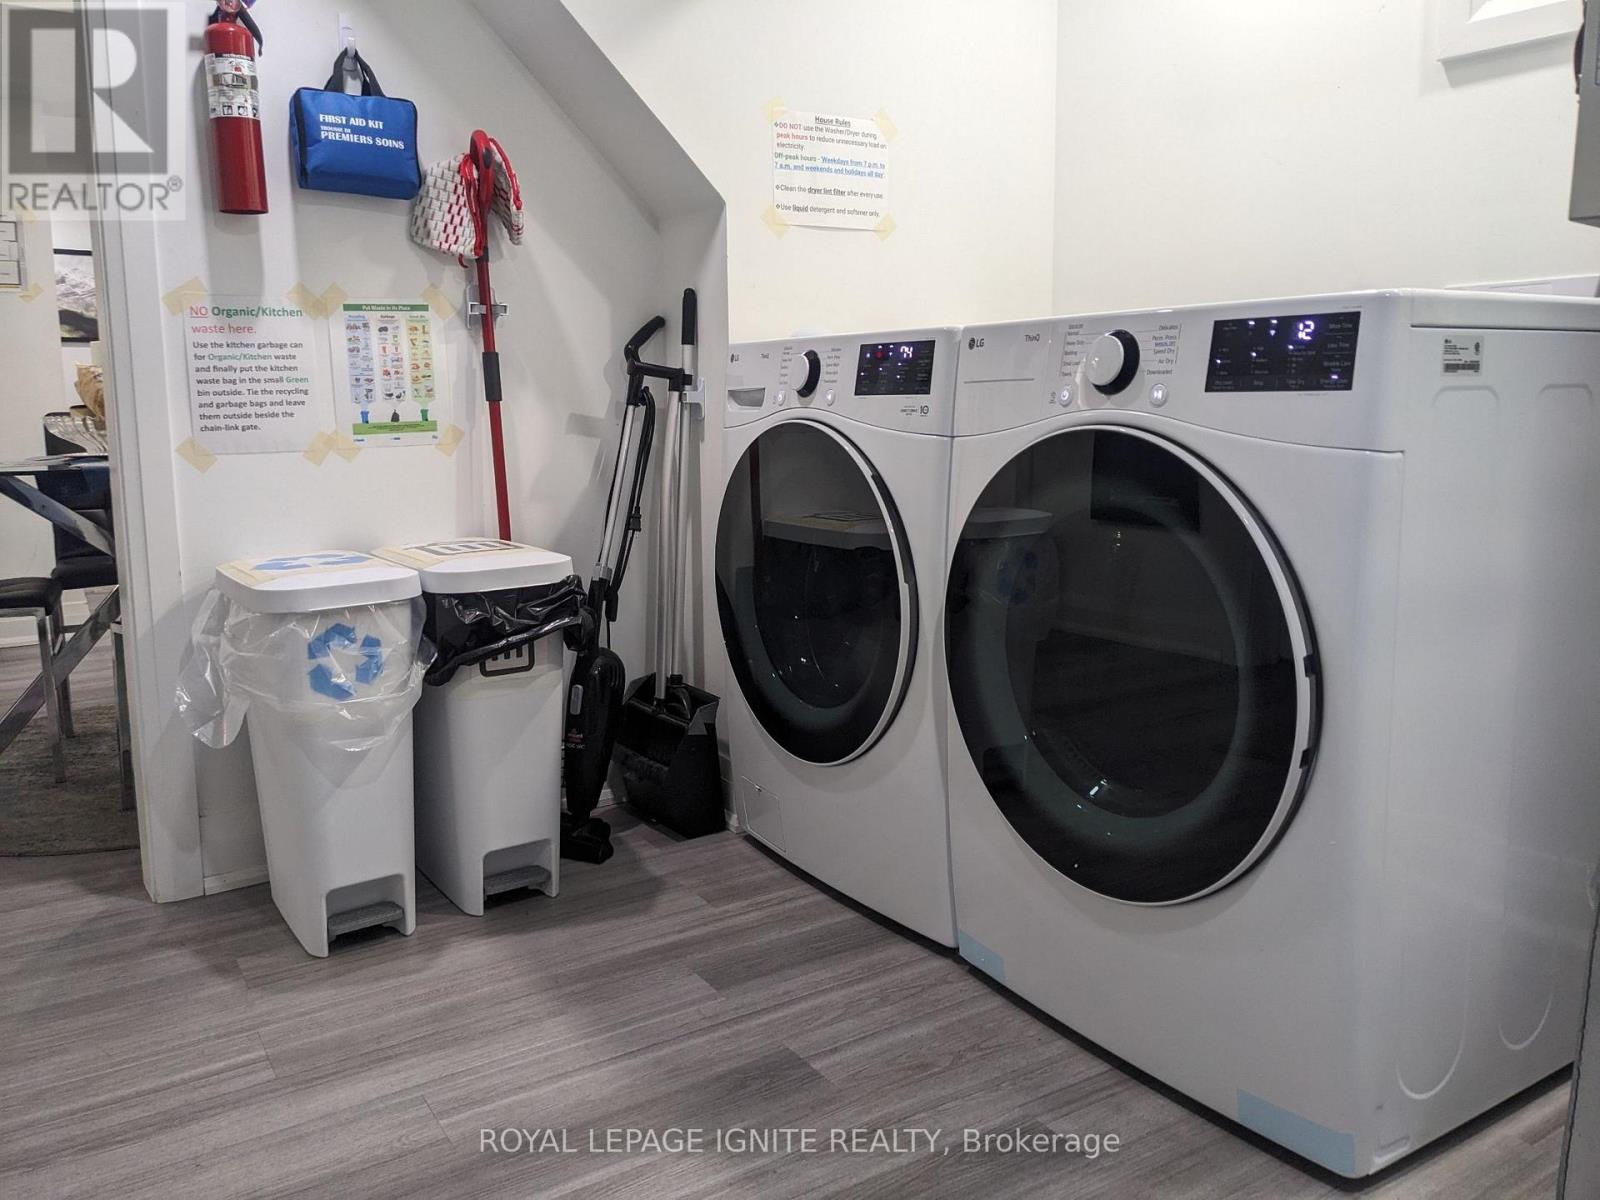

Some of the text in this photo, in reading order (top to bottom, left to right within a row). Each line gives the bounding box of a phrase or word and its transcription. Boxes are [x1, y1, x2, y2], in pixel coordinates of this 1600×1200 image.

[320, 113, 384, 130] FIRST AID KIT
[815, 115, 851, 128] House Rules
[779, 121, 788, 129] DO
[789, 122, 801, 130] NOT
[815, 125, 823, 133] the
[825, 126, 860, 138] Washer/Dryer
[861, 131, 877, 140] during
[321, 130, 405, 150] PREMIERS SOINS
[776, 132, 790, 140] peak
[792, 132, 808, 140] hours
[809, 134, 816, 142] to
[817, 135, 835, 144] reduce
[836, 138, 868, 149] unnecessary
[775, 151, 799, 161] Off-peak
[800, 153, 816, 162] hours
[821, 155, 849, 166] Weekdays
[850, 159, 863, 167] from
[794, 163, 804, 171] and
[805, 165, 833, 174] weekends
[834, 167, 844, 175] and
[780, 184, 797, 193] Clean
[797, 185, 806, 193] the
[808, 186, 822, 196] dryer
[833, 188, 846, 197] filter
[847, 189, 859, 197] after
[860, 191, 873, 200] every
[780, 203, 791, 212] Use
[792, 204, 809, 214] liquid
[810, 206, 835, 216] detergent
[836, 207, 846, 215] and
[190, 306, 303, 319] NO Organic/Kitchen
[192, 323, 257, 334] waste here.
[1025, 334, 1040, 343] ThinQ
[193, 341, 304, 351] Use the kitchen garbage can
[194, 352, 297, 363] for Organic/Kitchen waste
[195, 363, 298, 374] and finally put the kitchen
[196, 375, 309, 386] waste bag in the small Green
[197, 385, 309, 397] bin outside. Tie the recycling
[198, 396, 306, 410] and garbage bags and leave
[200, 408, 295, 420] them outside beside the
[200, 422, 261, 433] chain-link gate.
